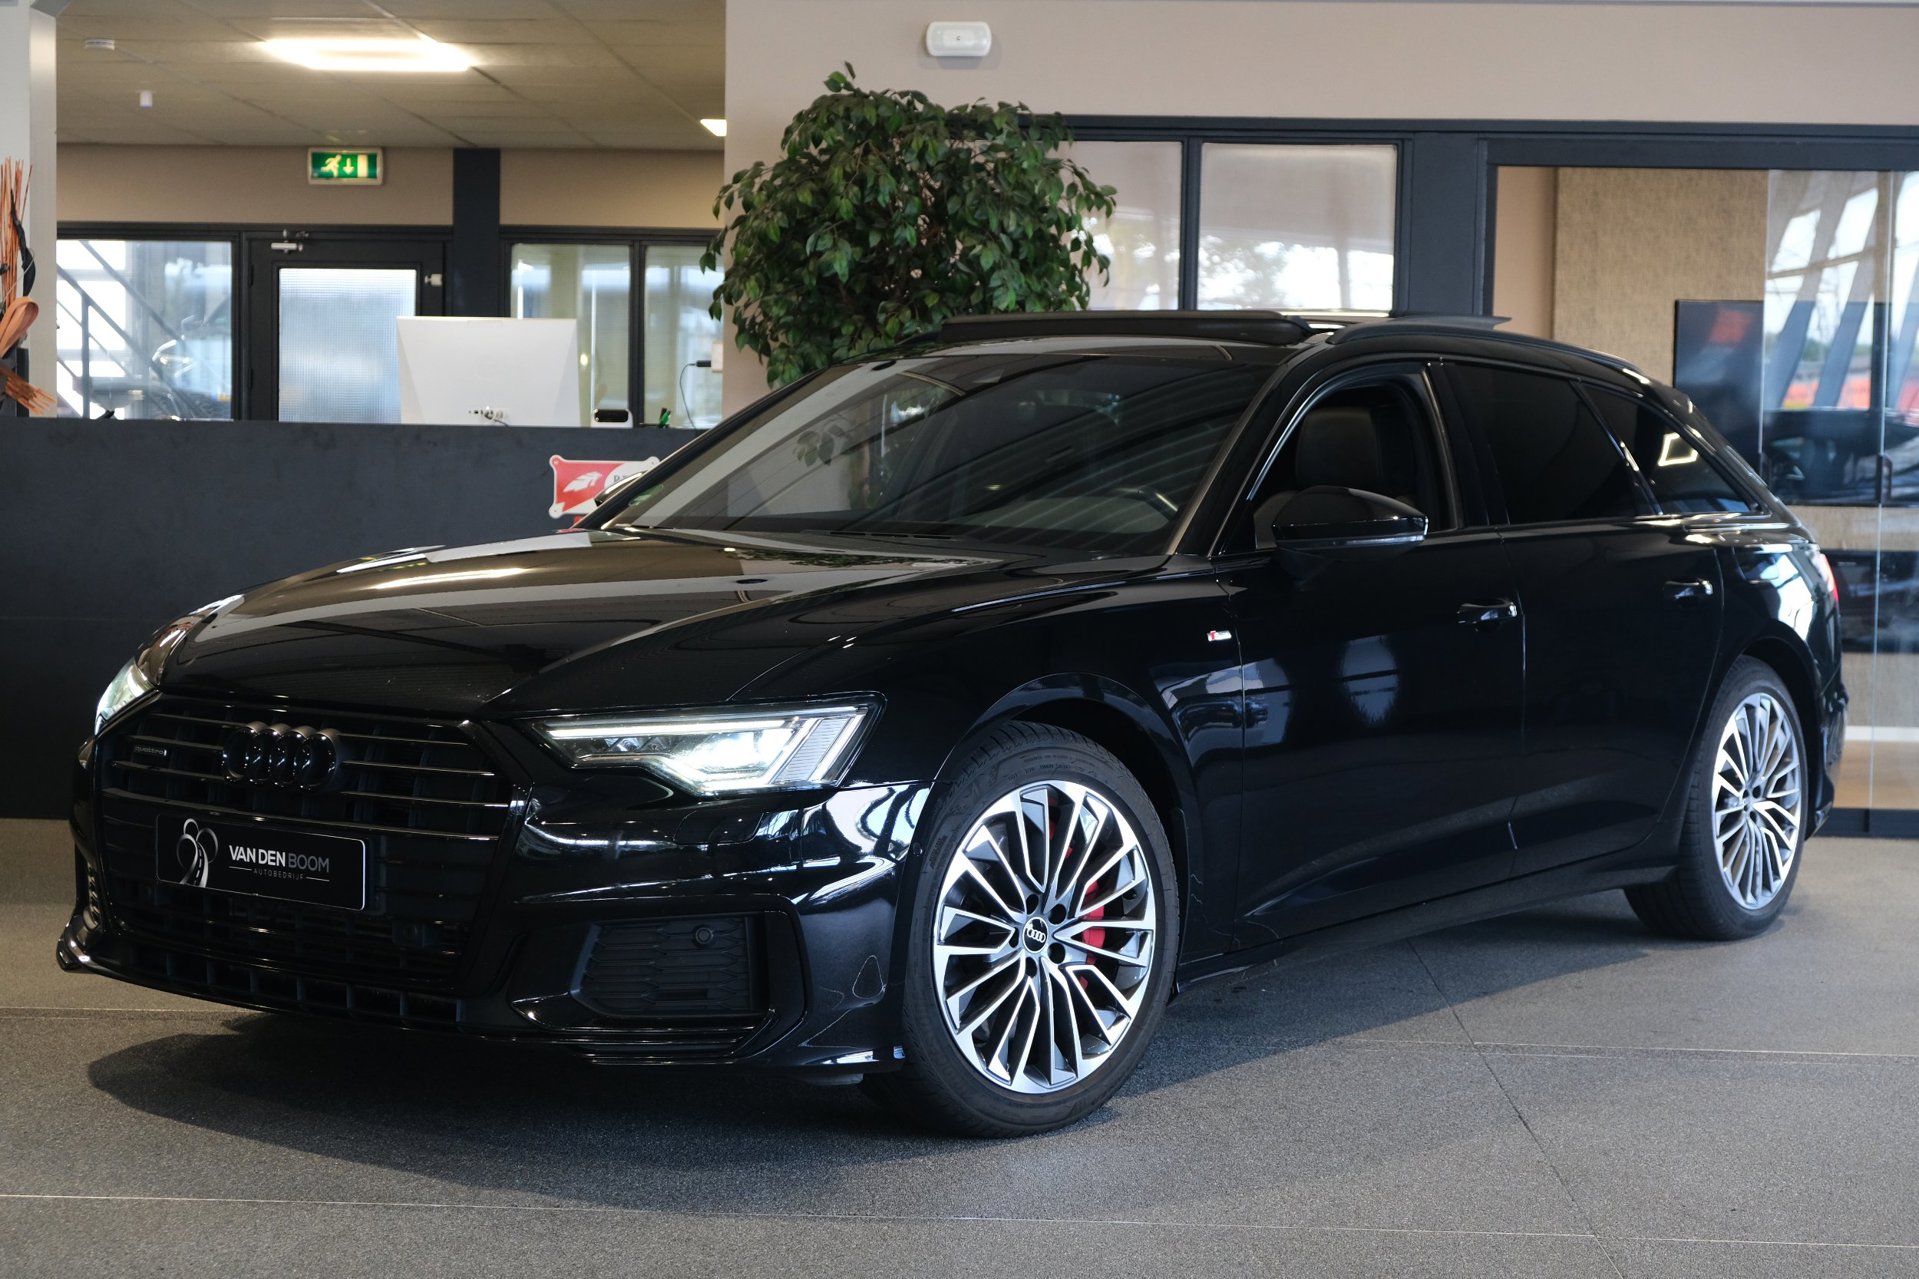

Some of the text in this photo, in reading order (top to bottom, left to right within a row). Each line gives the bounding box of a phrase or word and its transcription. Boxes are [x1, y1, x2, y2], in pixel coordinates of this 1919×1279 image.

[228, 844, 330, 873] VAN DEN BOOM
[254, 868, 304, 880] AUTOBEDRIJF
